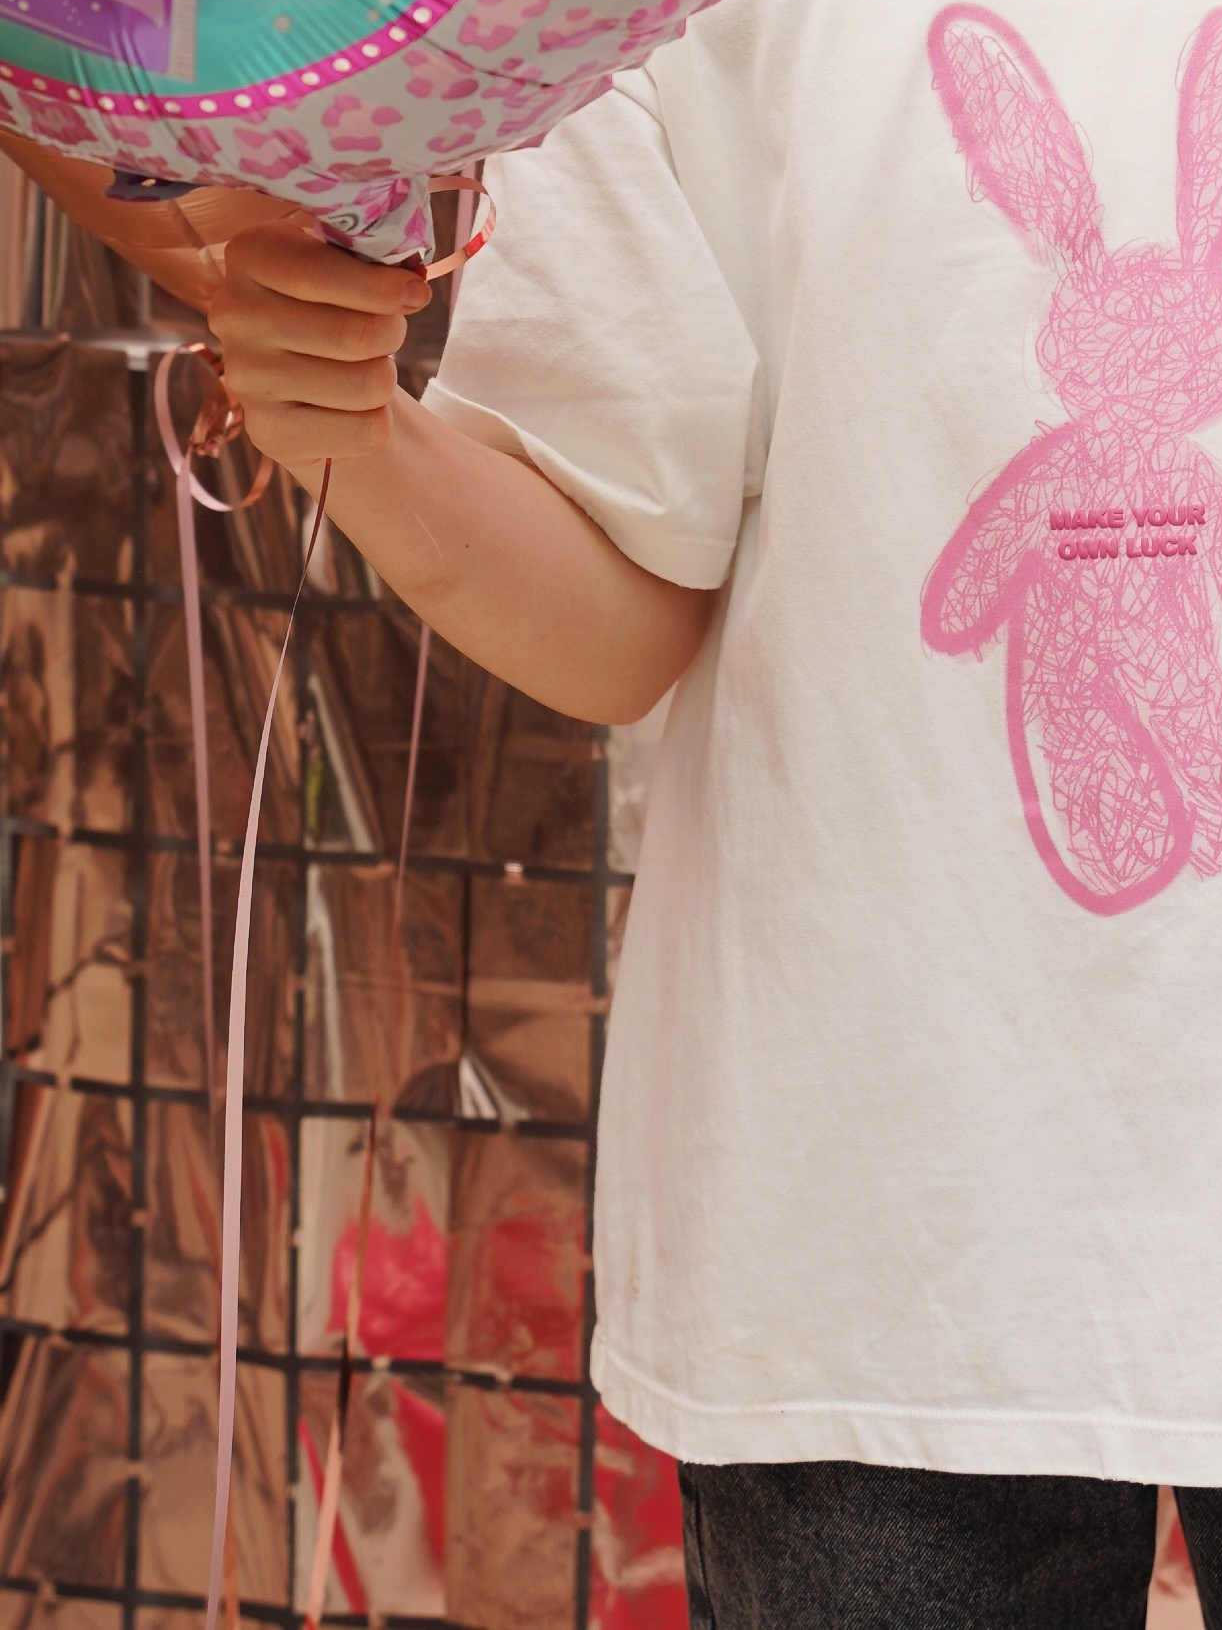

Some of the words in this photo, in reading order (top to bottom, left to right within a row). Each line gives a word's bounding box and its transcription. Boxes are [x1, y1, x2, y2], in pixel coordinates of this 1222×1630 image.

[1050, 507, 1125, 531] MAKE
[1131, 503, 1206, 528] YOUR
[1058, 537, 1119, 561] OWN
[1125, 534, 1198, 559] LUCK
